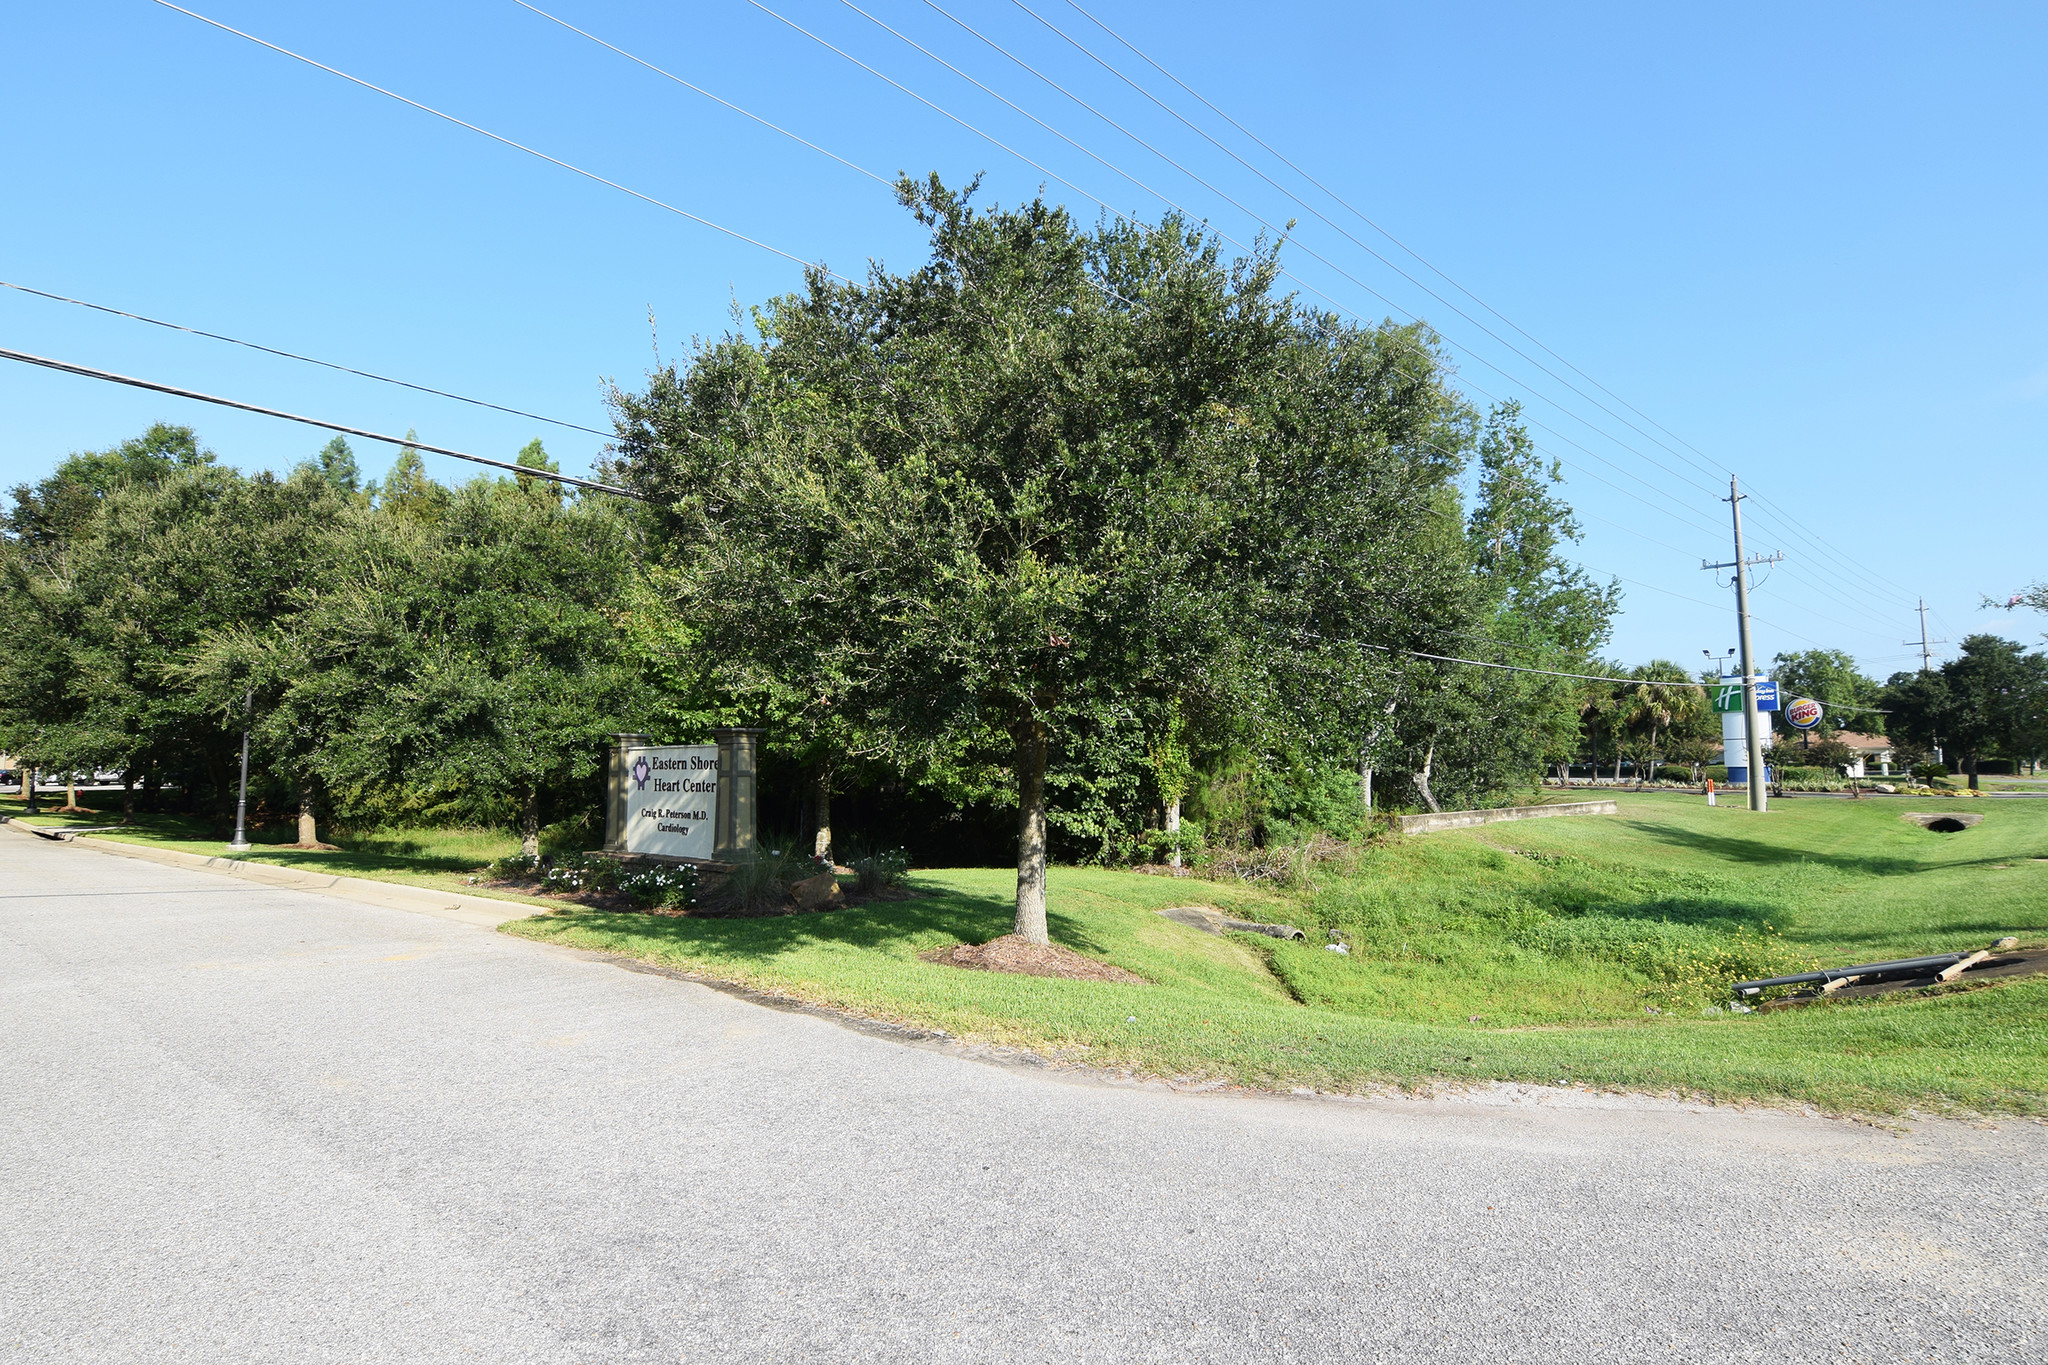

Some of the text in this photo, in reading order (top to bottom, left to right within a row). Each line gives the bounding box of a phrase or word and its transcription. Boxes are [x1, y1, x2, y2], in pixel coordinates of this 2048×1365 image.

[1790, 703, 1816, 715] BURGER
[1791, 708, 1817, 721] KING
[652, 756, 718, 770] Eastern Shore
[654, 778, 716, 793] Heart Center
[641, 808, 708, 820] Craig R. Peterson M.D.
[657, 823, 688, 835] Cardiology
